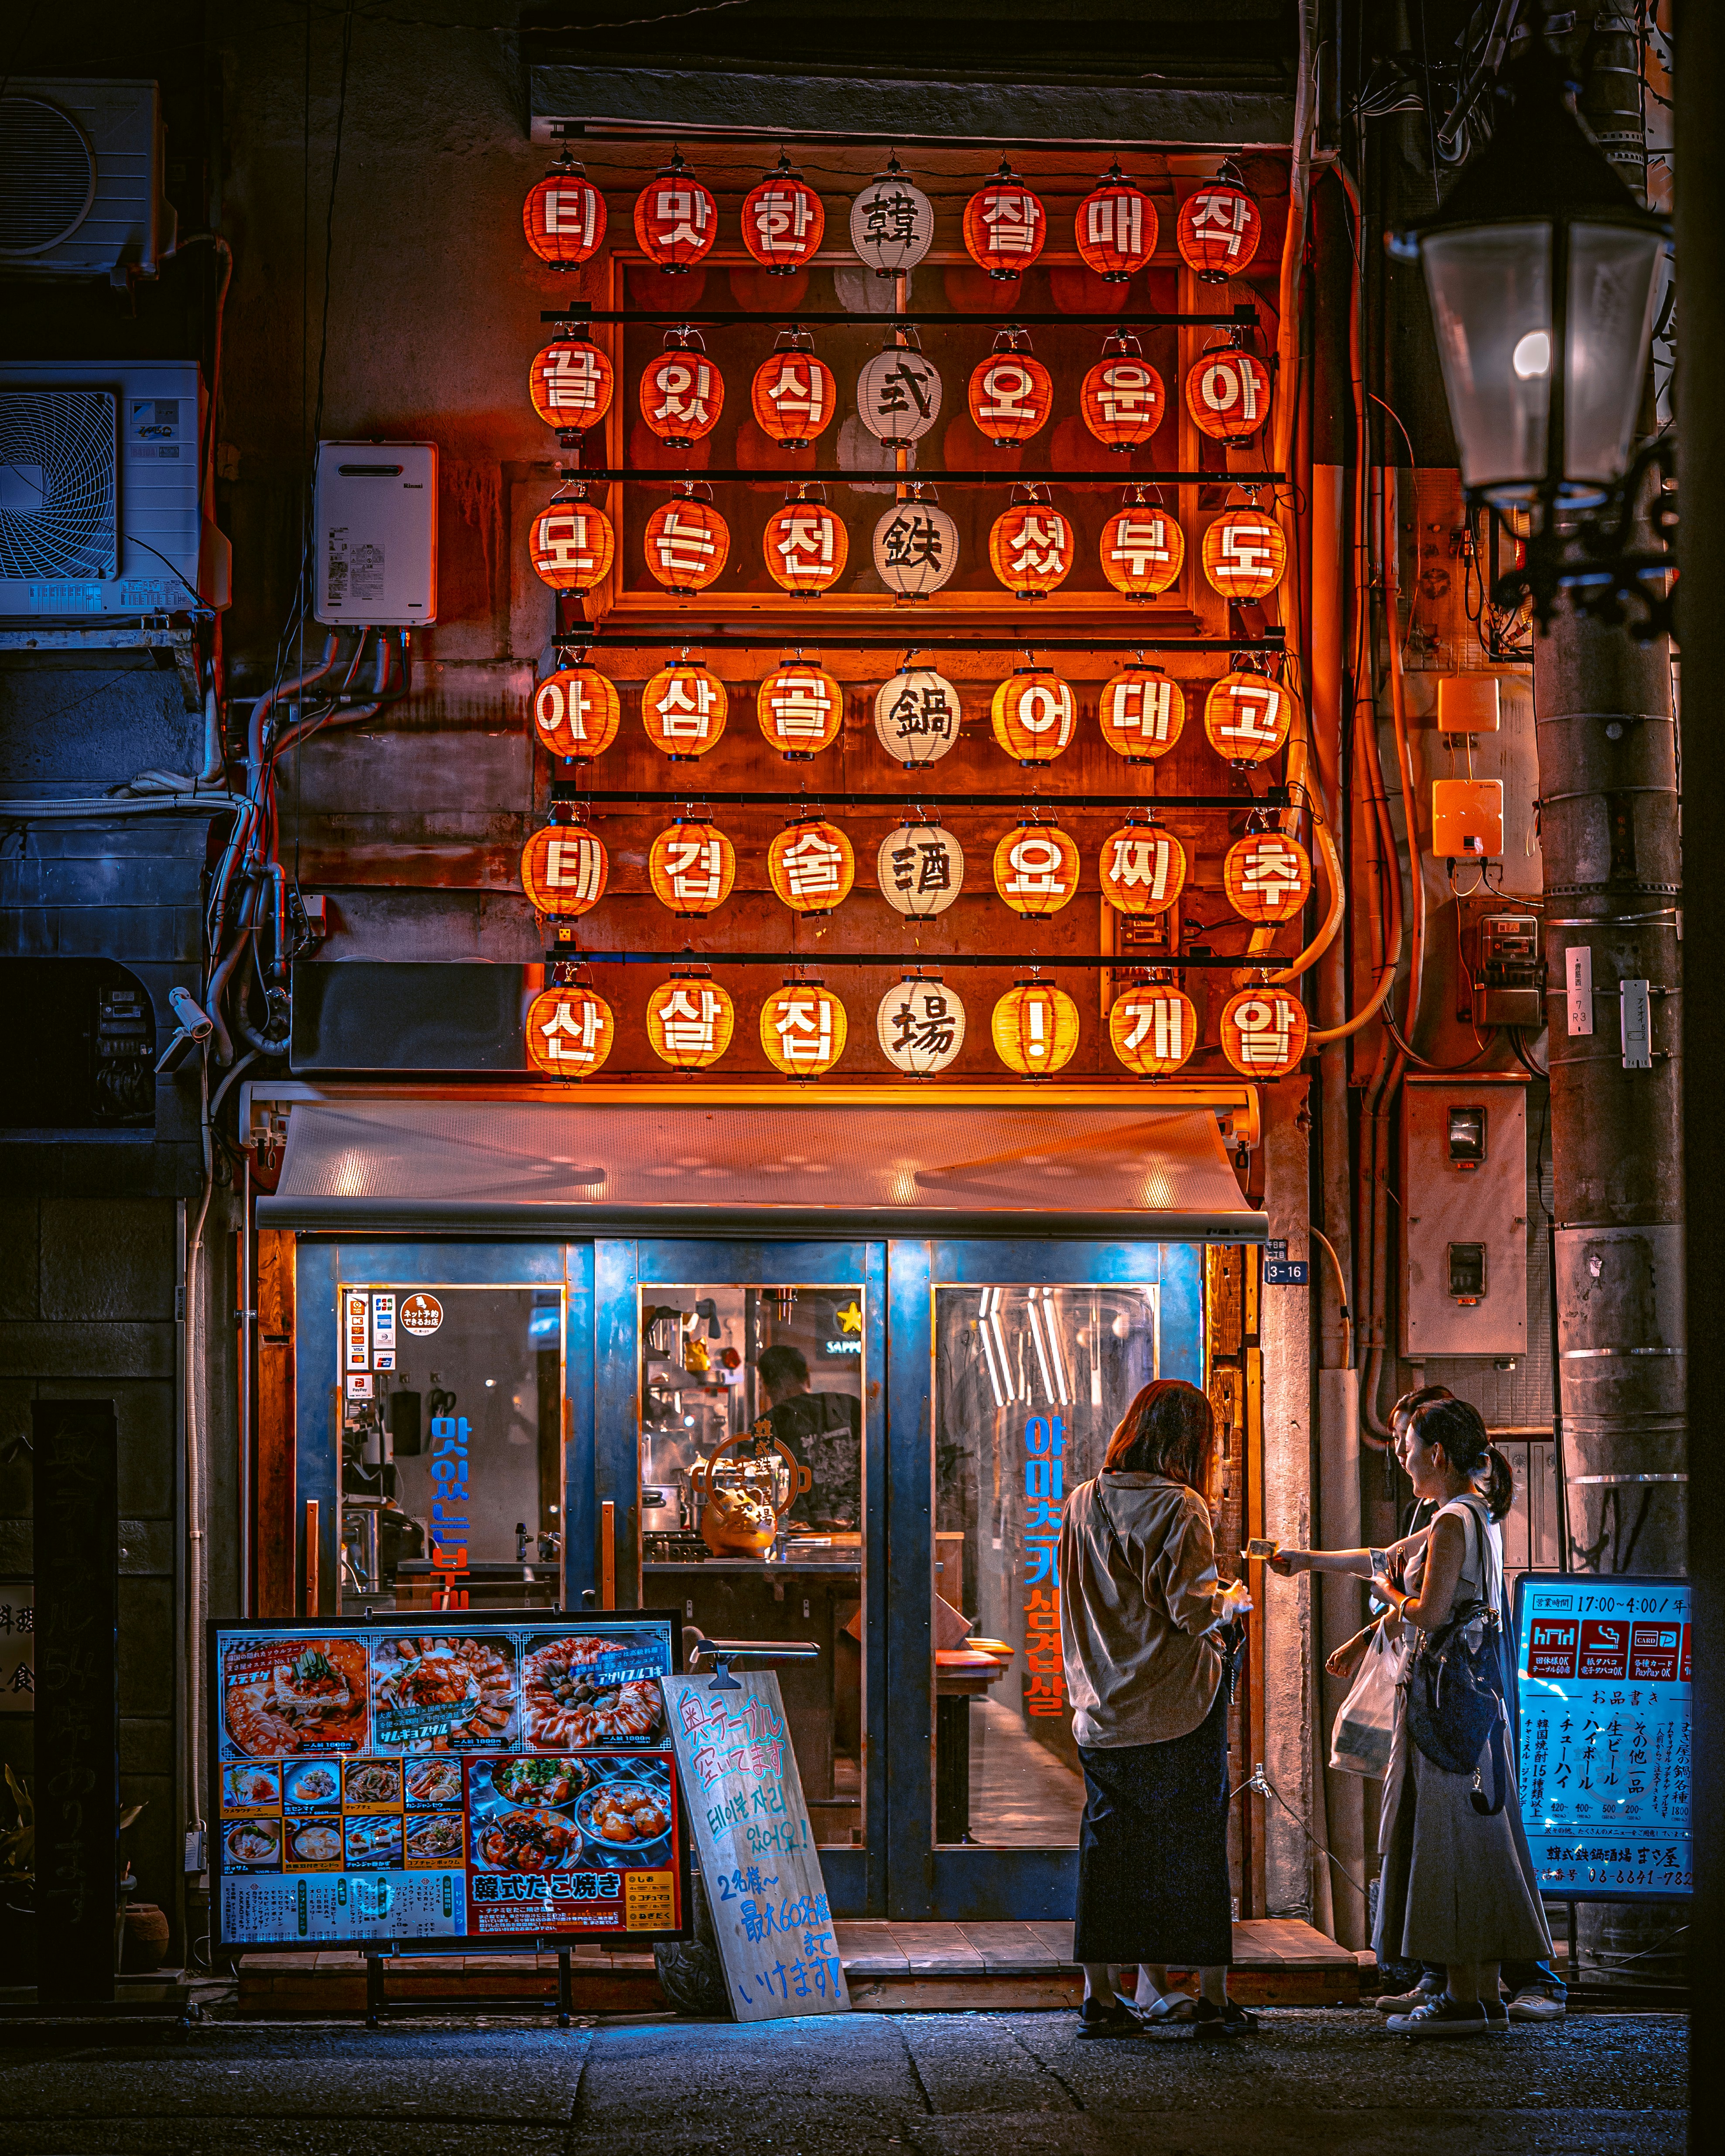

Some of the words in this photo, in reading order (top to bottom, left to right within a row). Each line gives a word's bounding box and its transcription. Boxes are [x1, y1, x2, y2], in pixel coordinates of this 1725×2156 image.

[1576, 1000, 1581, 1010] 7
[1270, 1266, 1301, 1277] 3-16
[404, 1310, 439, 1318] ネット予約
[1536, 1598, 1569, 1608] 営業時間
[1532, 1665, 1571, 1674] テーブル60席
[1536, 1656, 1568, 1665] 団体様OK
[1581, 1667, 1622, 1677] 電子タバコOK
[1635, 1660, 1673, 1668] 各種カード
[1635, 1667, 1659, 1677] PayPay
[1661, 1668, 1670, 1677] OK
[1592, 1690, 1660, 1706] お品書き
[679, 1688, 781, 1746] 奥テーブル
[380, 1723, 448, 1742] サムギョプサル
[1554, 1718, 1574, 1789] チューハイ
[1578, 1718, 1600, 1790] ハイボール
[1605, 1721, 1624, 1786] 生ビール
[1628, 1721, 1648, 1794] その他一品
[1671, 1721, 1692, 1805] まさ屋の鍋各種
[694, 1742, 784, 1789] 空いてます
[1528, 1718, 1549, 1818] 韓国焼酎15種類以上
[707, 1791, 747, 1836] 테이블
[751, 1785, 786, 1814] 자리
[1602, 1804, 1616, 1814] 500
[1671, 1806, 1689, 1816] 1800
[746, 1819, 808, 1856] 있어요!
[1547, 1845, 1633, 1863] 韓式鉄鍋酒場
[1637, 1846, 1681, 1868] まさ屋
[473, 1872, 620, 1901] 韓式たこ焼き
[430, 1922, 435, 1932] モモ
[741, 1892, 832, 1943] 最大60名様
[804, 1931, 832, 1957] まで
[739, 1956, 841, 2004] いけます!
